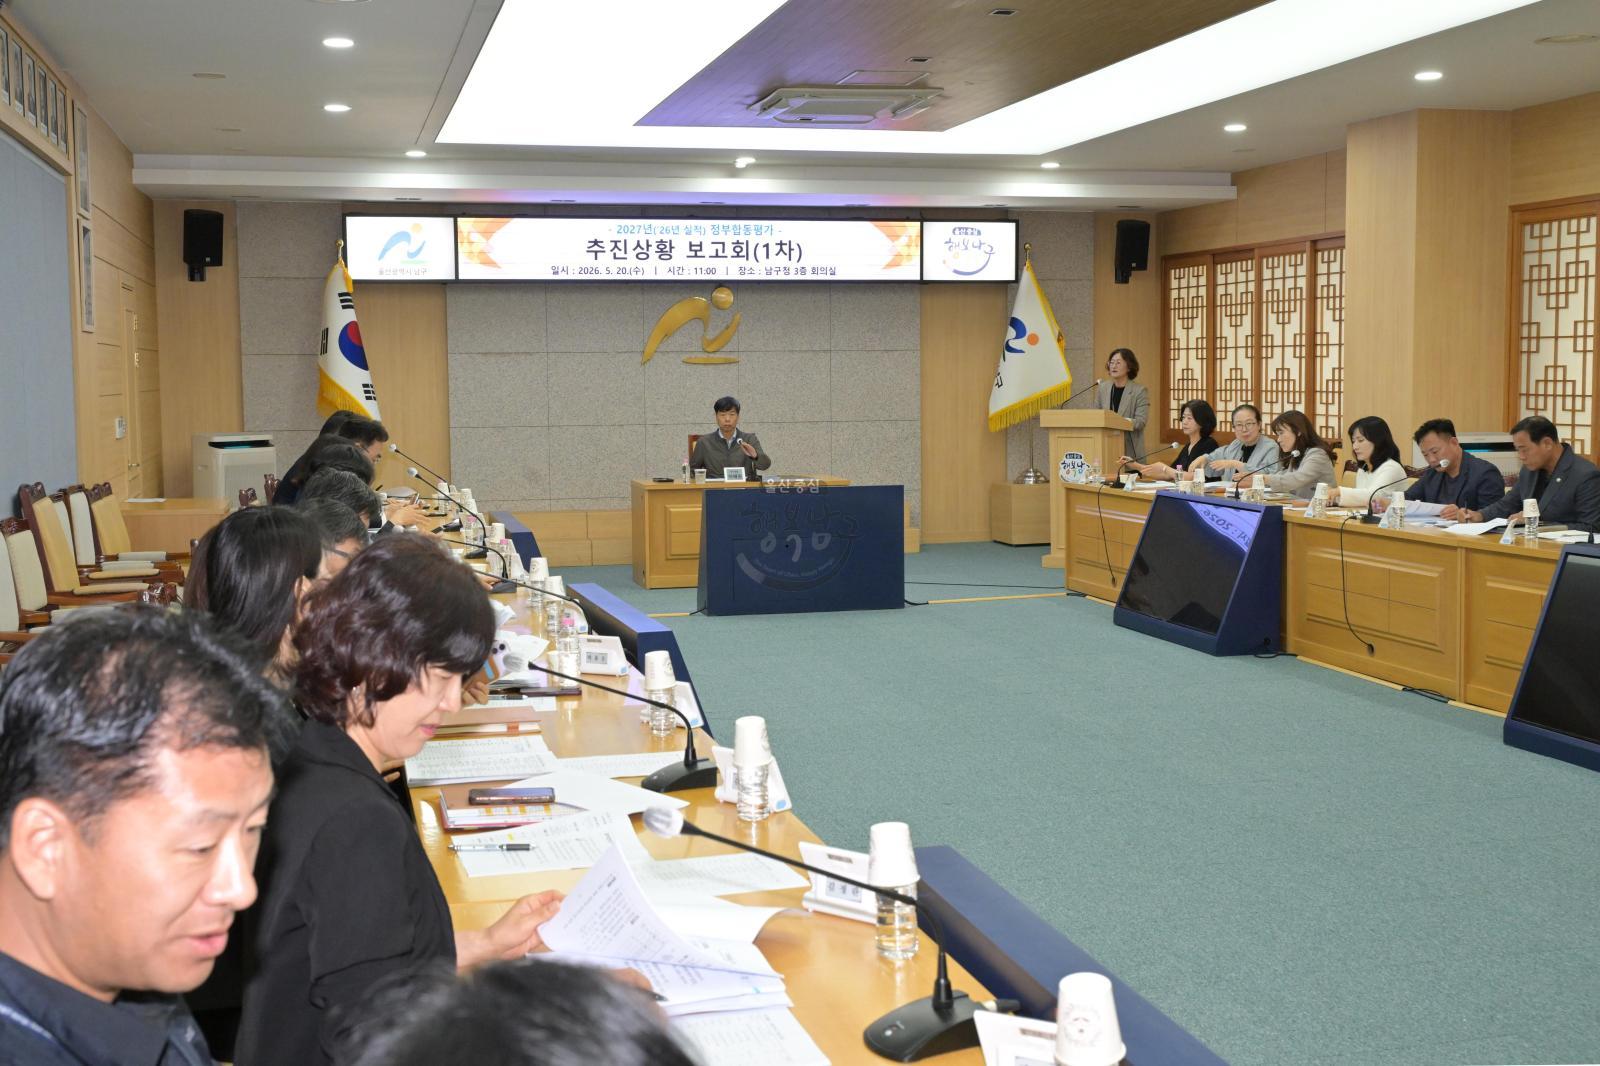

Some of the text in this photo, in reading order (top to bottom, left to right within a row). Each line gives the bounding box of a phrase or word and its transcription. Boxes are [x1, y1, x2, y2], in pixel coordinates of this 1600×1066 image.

[684, 224, 706, 236] 실적)
[710, 223, 774, 236] 정부합동평가
[585, 239, 803, 263] 추진상황 보고회(1차)
[551, 266, 569, 276] 일시
[578, 266, 602, 275] 2026.
[605, 266, 613, 275] 5.
[616, 266, 645, 277] 20.(수)
[667, 266, 685, 276] 시간
[694, 267, 717, 276] 11:00
[738, 266, 756, 276] 장소
[764, 266, 790, 276] 남구청
[794, 267, 807, 276] 3층
[811, 266, 836, 276] 회의실
